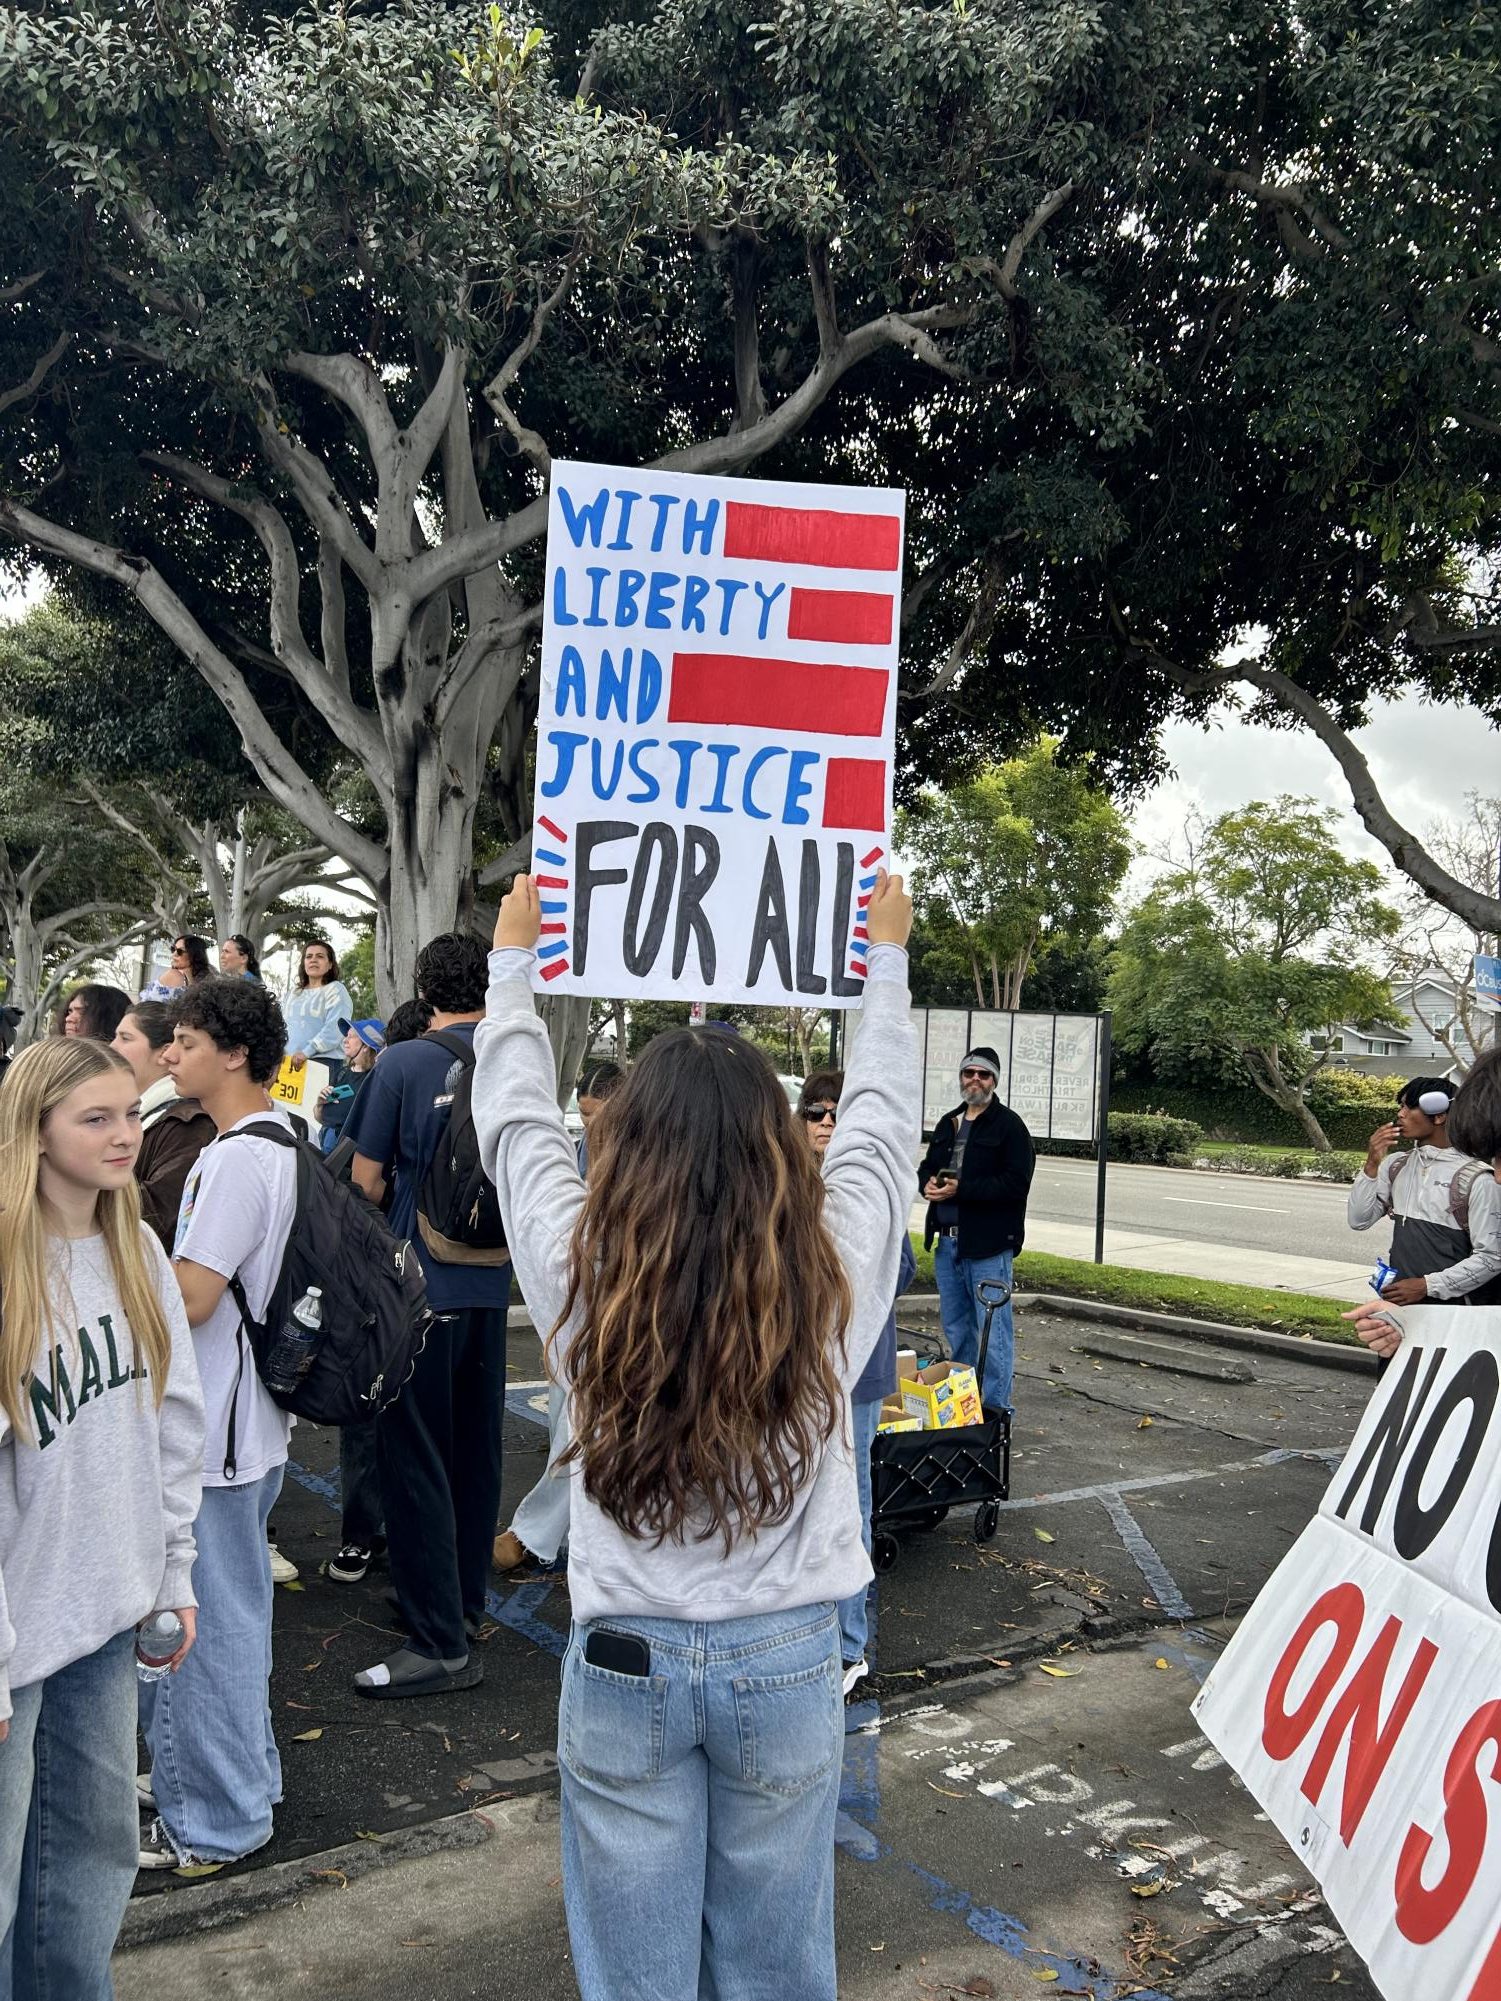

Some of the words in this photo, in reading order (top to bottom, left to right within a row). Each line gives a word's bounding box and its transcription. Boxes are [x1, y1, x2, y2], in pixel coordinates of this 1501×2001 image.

[558, 485, 721, 556] WITH
[553, 566, 787, 641] LIBERTY
[555, 644, 663, 726] AND
[541, 731, 821, 825] JUSTICE
[572, 820, 721, 987] FOR
[745, 834, 867, 997] ALL
[280, 1083, 299, 1101] ICE
[1335, 1346, 1500, 1561] NO
[1261, 1582, 1439, 1849] ON
[1394, 1697, 1501, 2001] S
